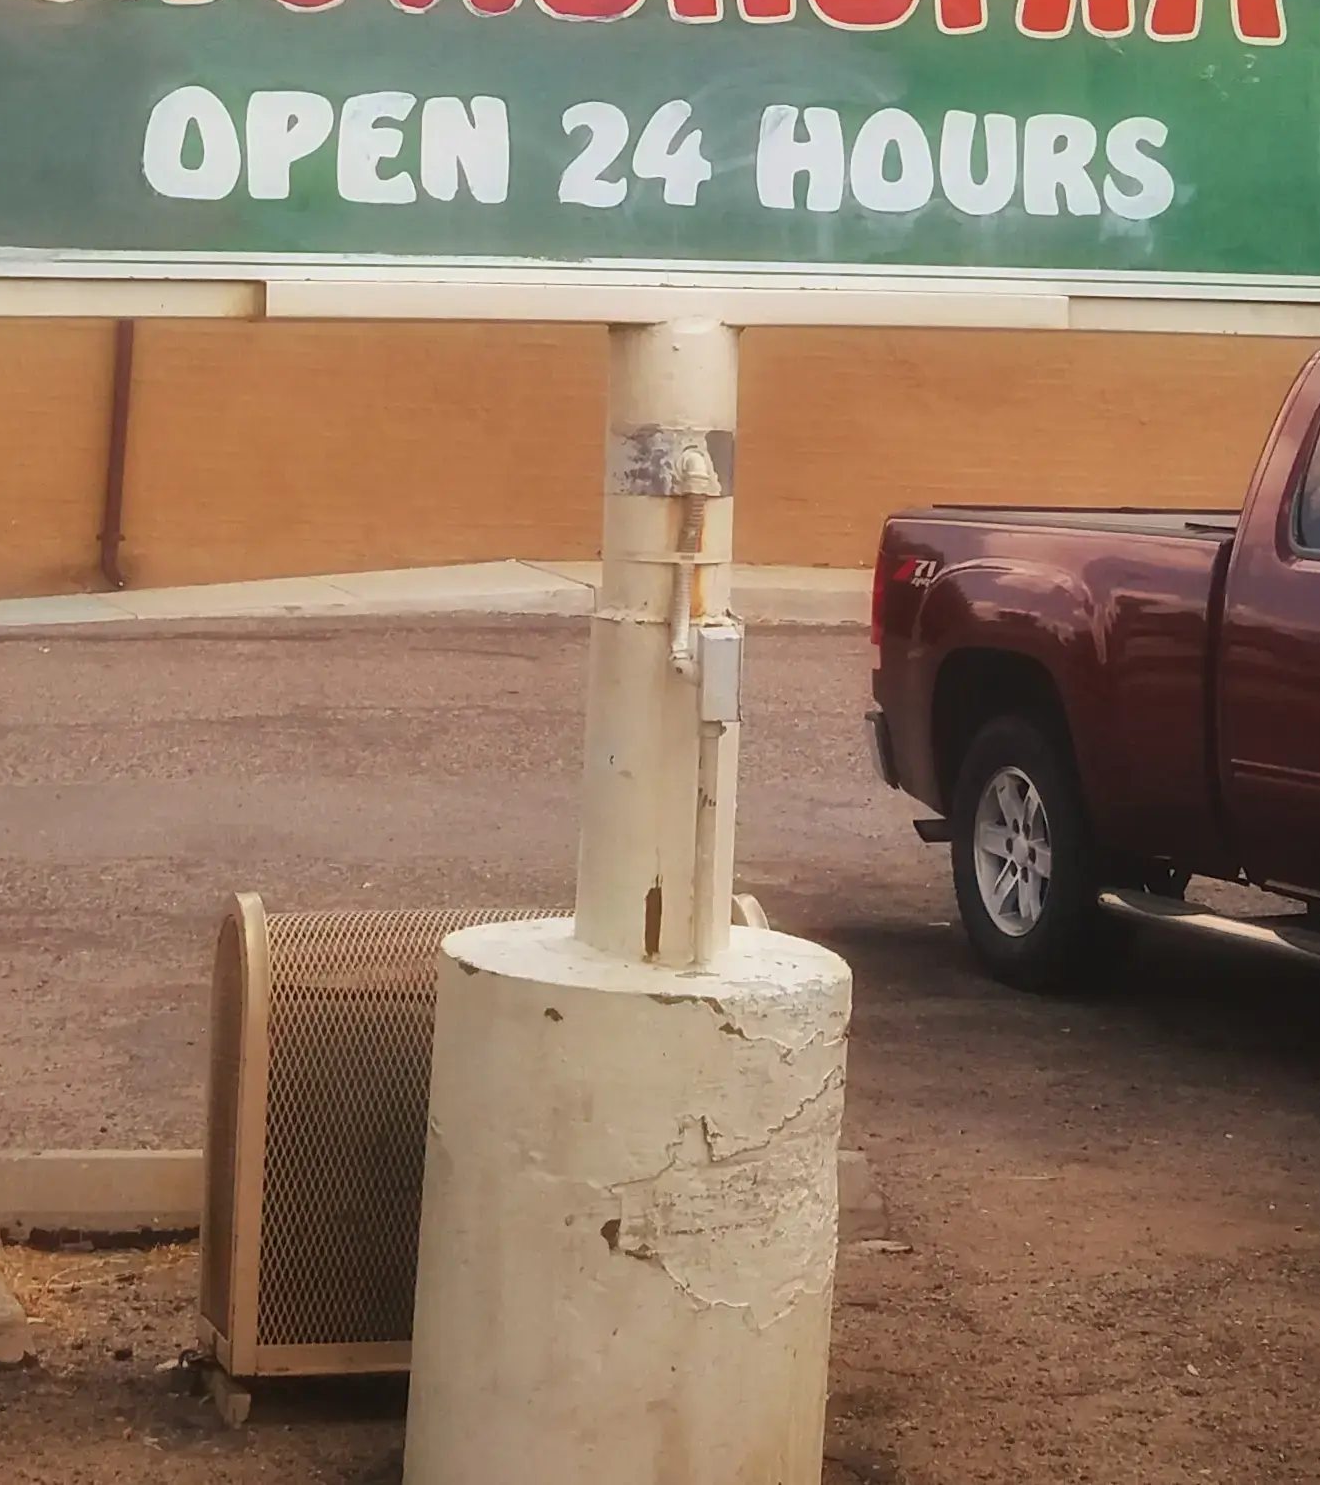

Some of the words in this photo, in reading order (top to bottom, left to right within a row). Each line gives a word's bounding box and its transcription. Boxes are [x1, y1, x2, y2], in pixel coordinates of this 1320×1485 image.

[142, 85, 510, 204] OPEN
[558, 100, 713, 208] 24
[755, 105, 1176, 221] HOURS
